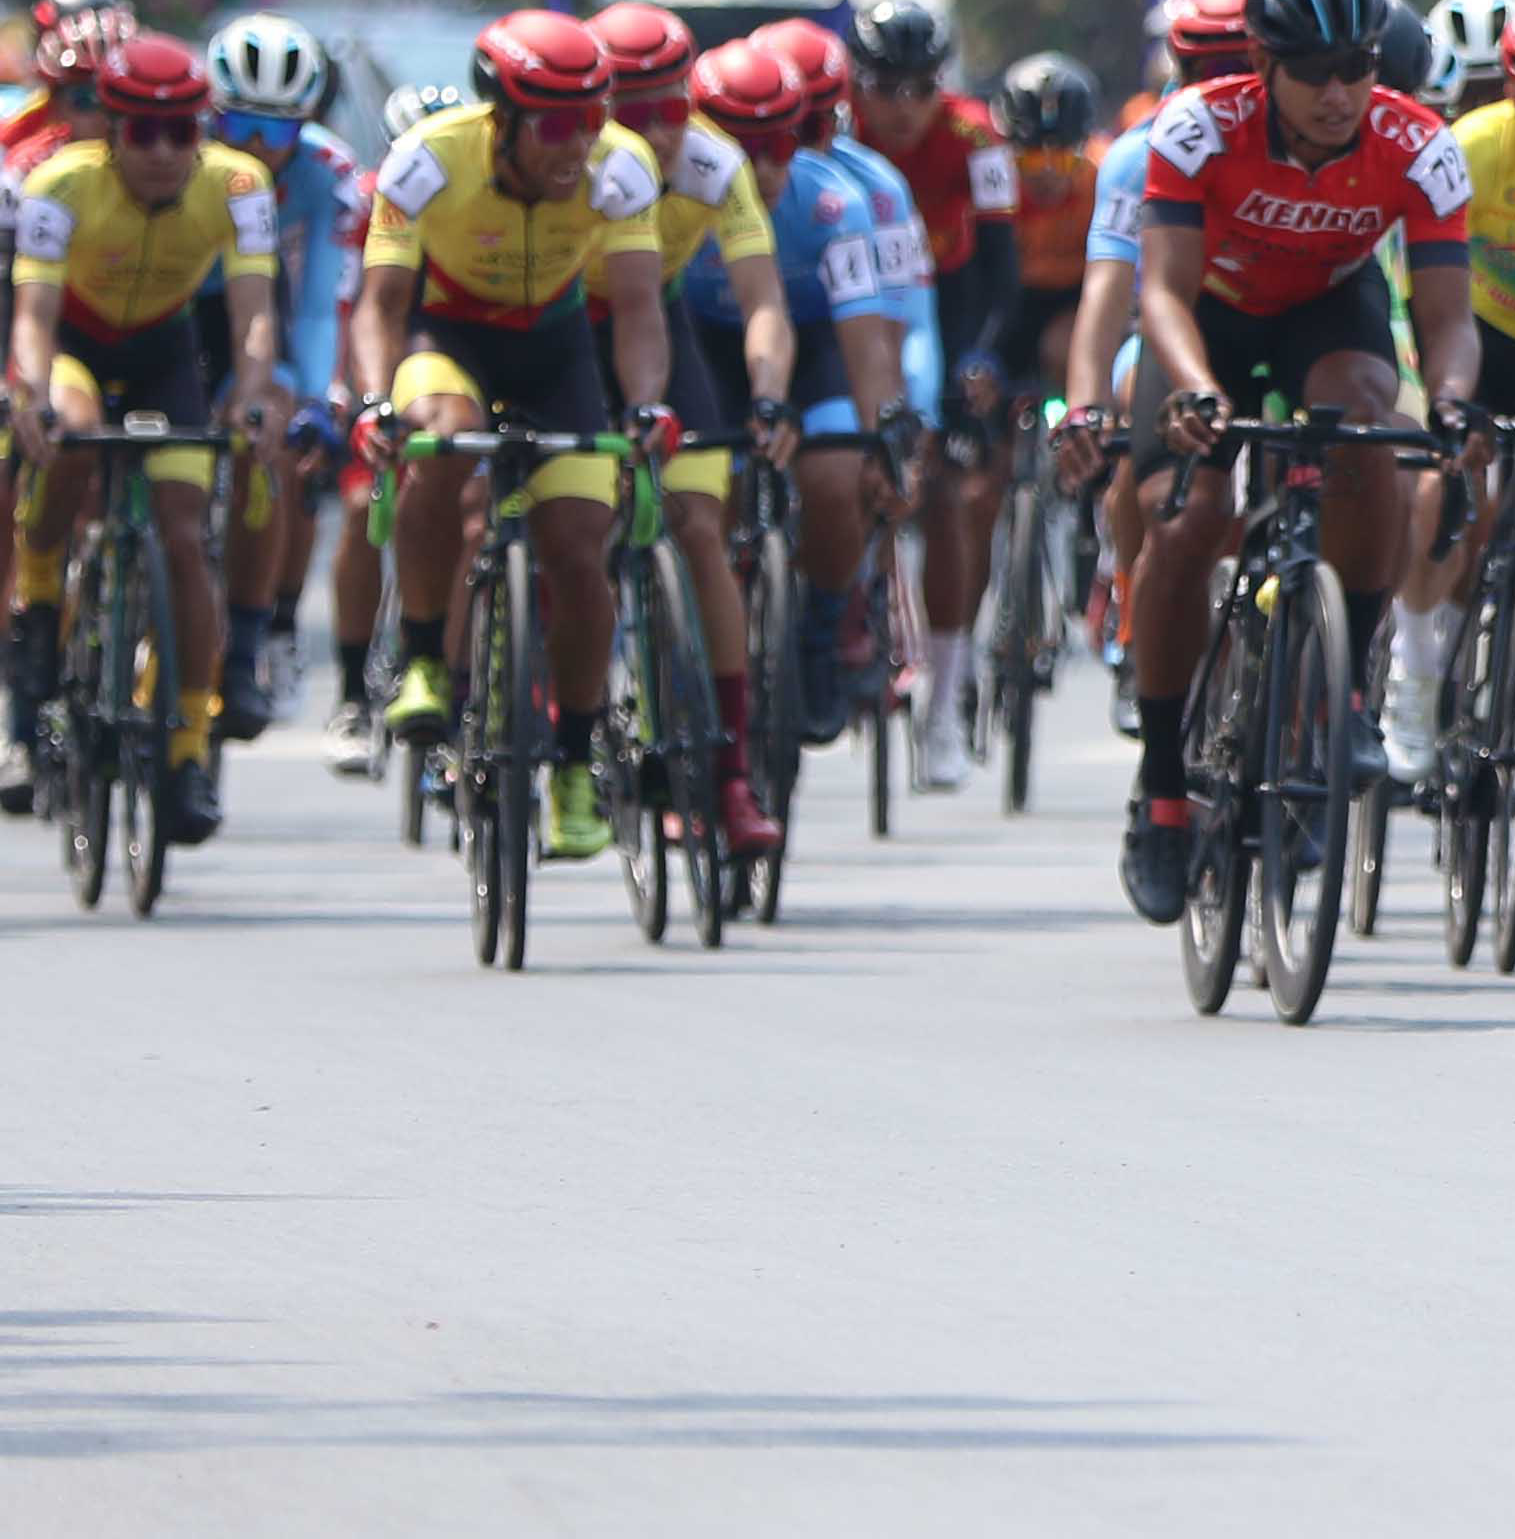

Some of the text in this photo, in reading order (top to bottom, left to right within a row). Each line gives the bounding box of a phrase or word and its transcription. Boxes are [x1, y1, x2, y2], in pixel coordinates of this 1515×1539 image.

[1164, 110, 1204, 154] 72
[1429, 147, 1468, 193] 72
[1234, 189, 1383, 235] KENDA
